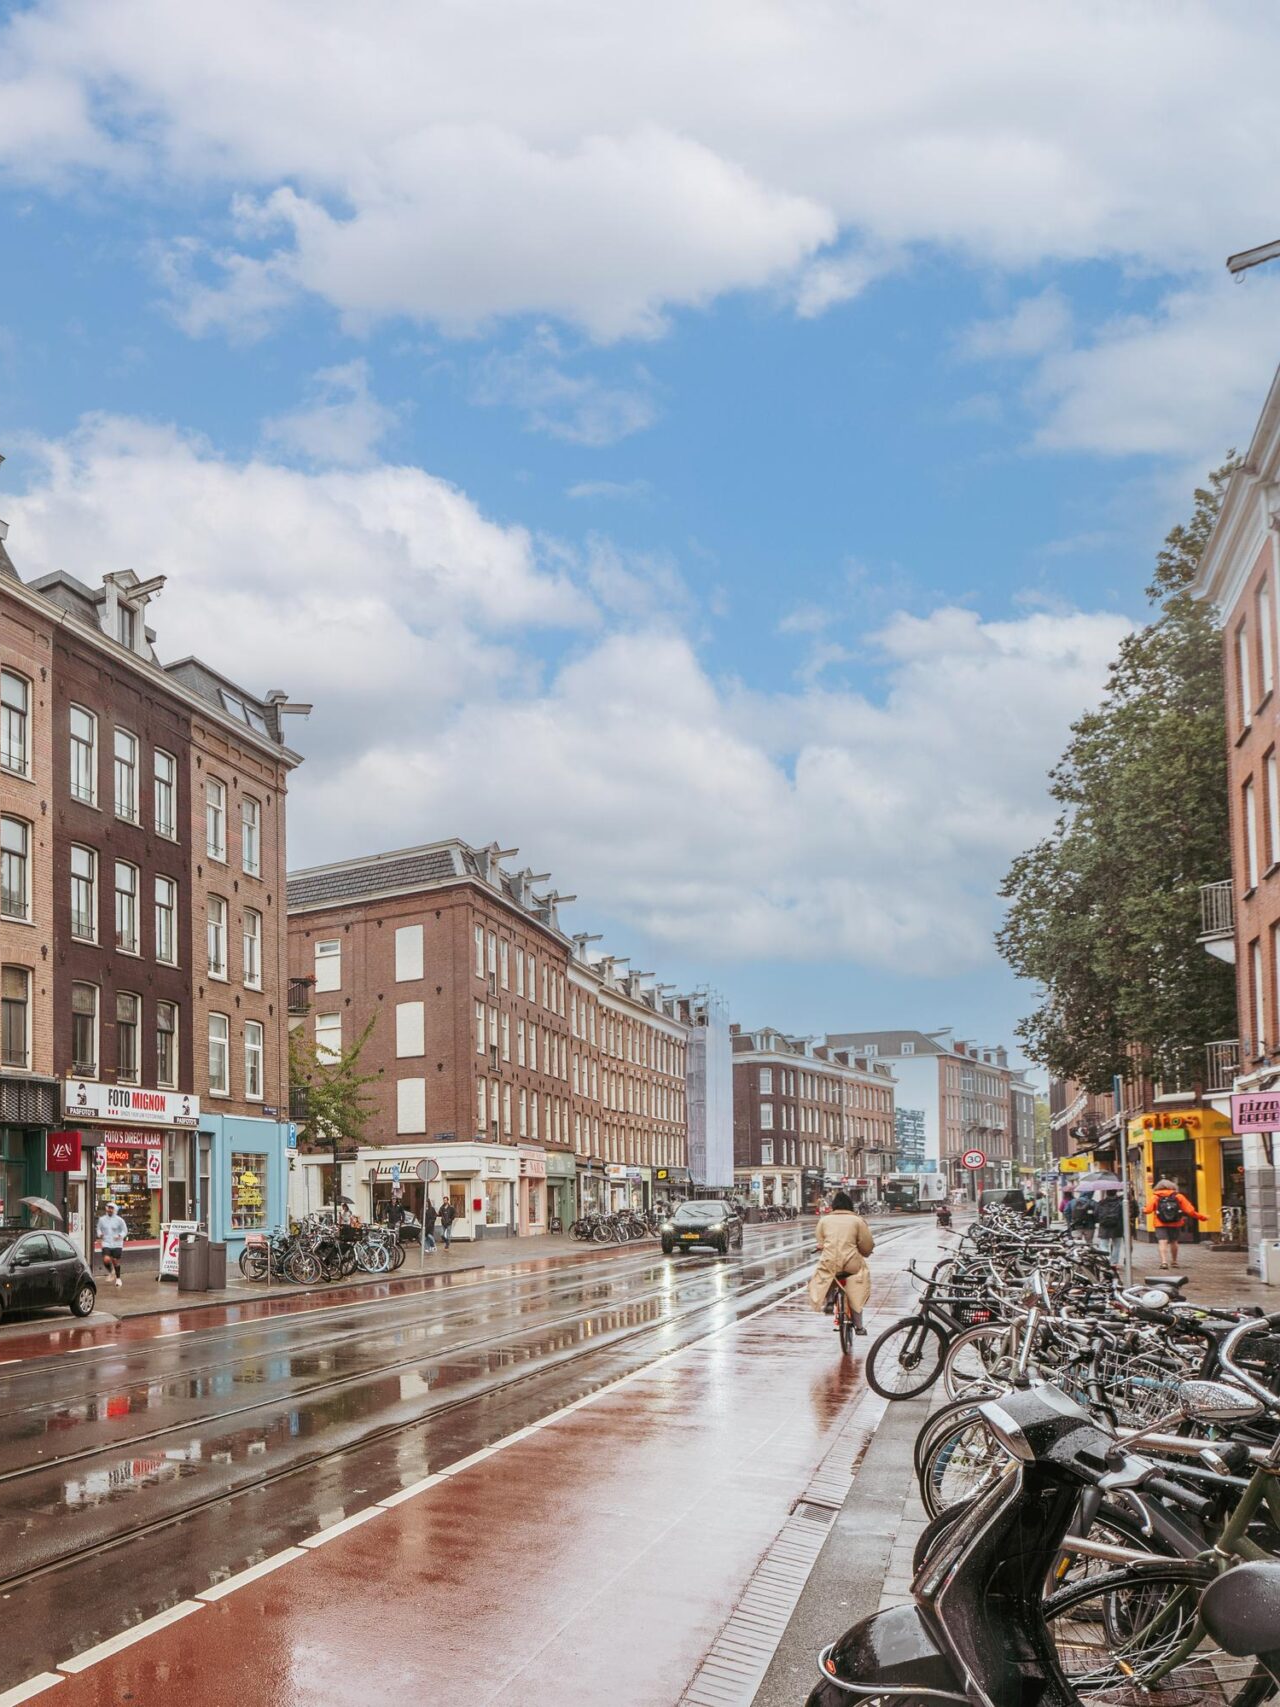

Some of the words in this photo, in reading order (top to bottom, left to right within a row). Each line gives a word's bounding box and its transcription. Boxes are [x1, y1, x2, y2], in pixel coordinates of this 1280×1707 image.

[108, 1088, 130, 1108] FOTO
[132, 1092, 166, 1112] MIGNON
[104, 1131, 123, 1143] FOTO'S
[124, 1132, 144, 1144] DIRECT
[967, 1155, 981, 1164] 30
